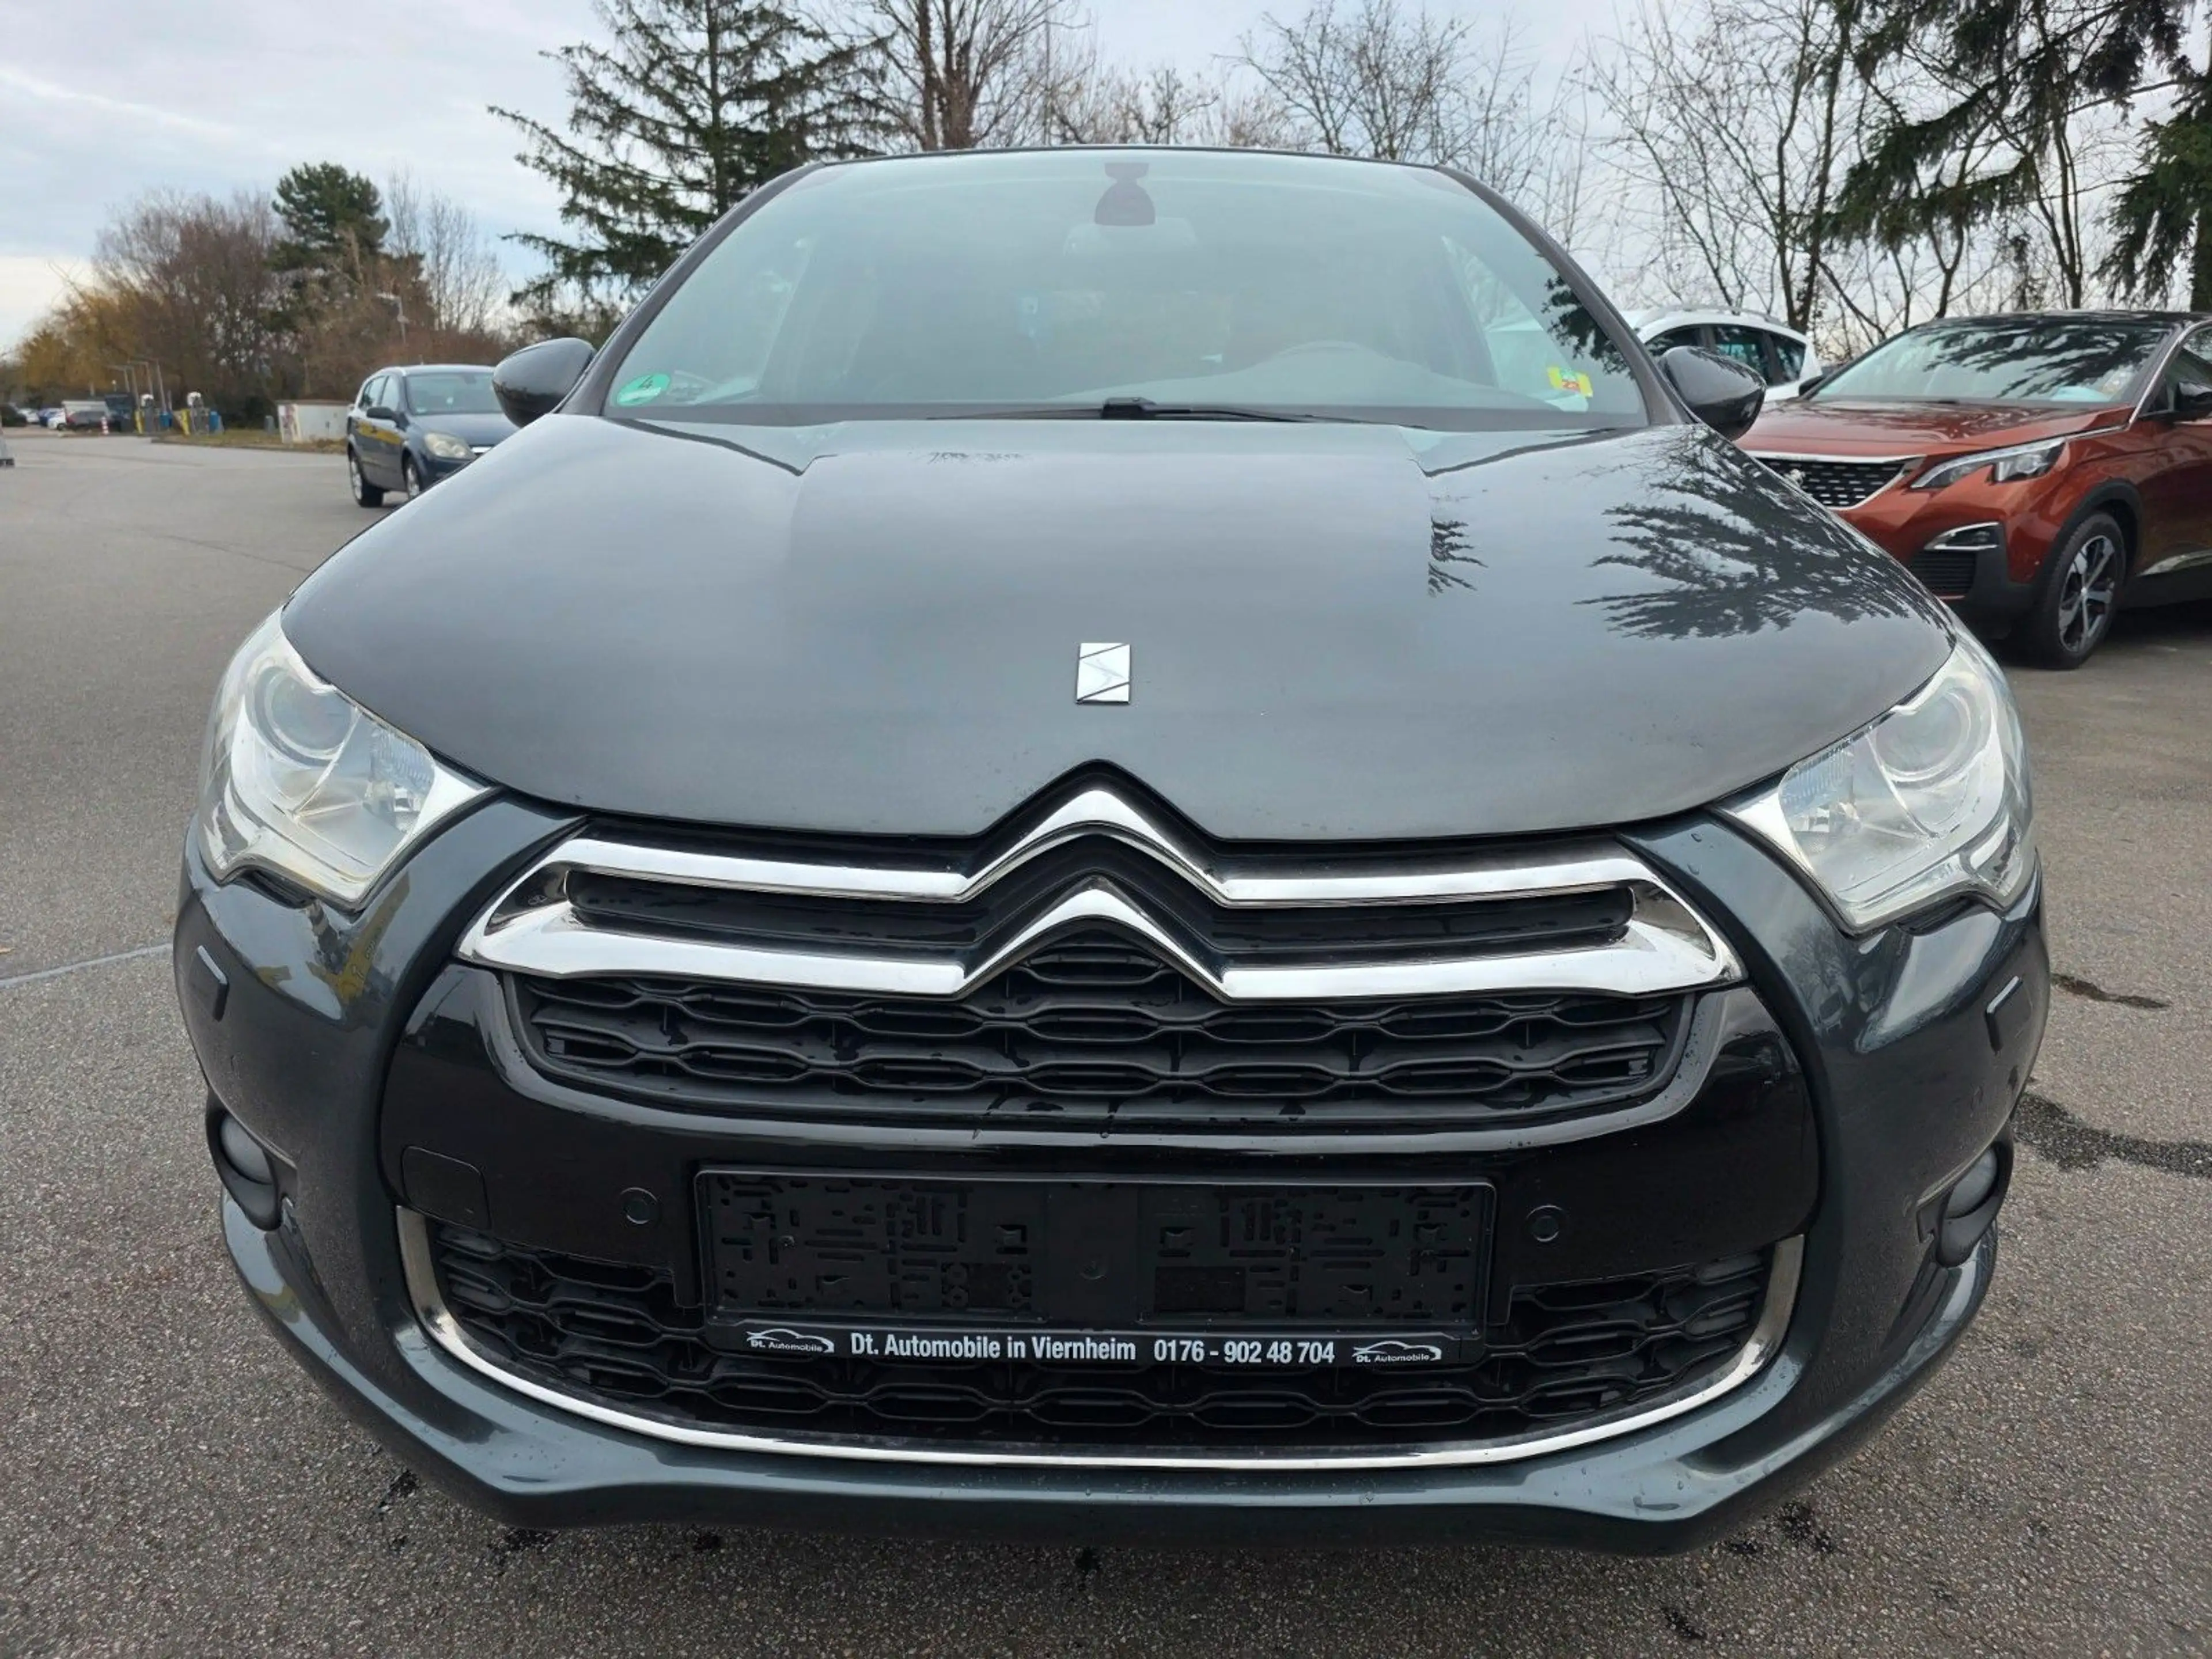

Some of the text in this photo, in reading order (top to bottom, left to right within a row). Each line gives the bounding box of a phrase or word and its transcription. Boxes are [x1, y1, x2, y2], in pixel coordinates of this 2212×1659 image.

[768, 1341, 823, 1352] Automobile
[851, 1332, 878, 1355] Dt.
[884, 1334, 1001, 1358] Automobile
[1007, 1336, 1026, 1358] in
[1031, 1336, 1136, 1360] Viernheim
[1154, 1339, 1205, 1362] 0176
[1224, 1340, 1262, 1363] 902
[1266, 1341, 1292, 1363] 48
[1297, 1342, 1335, 1363] 704
[1374, 1354, 1430, 1362] Automobile
